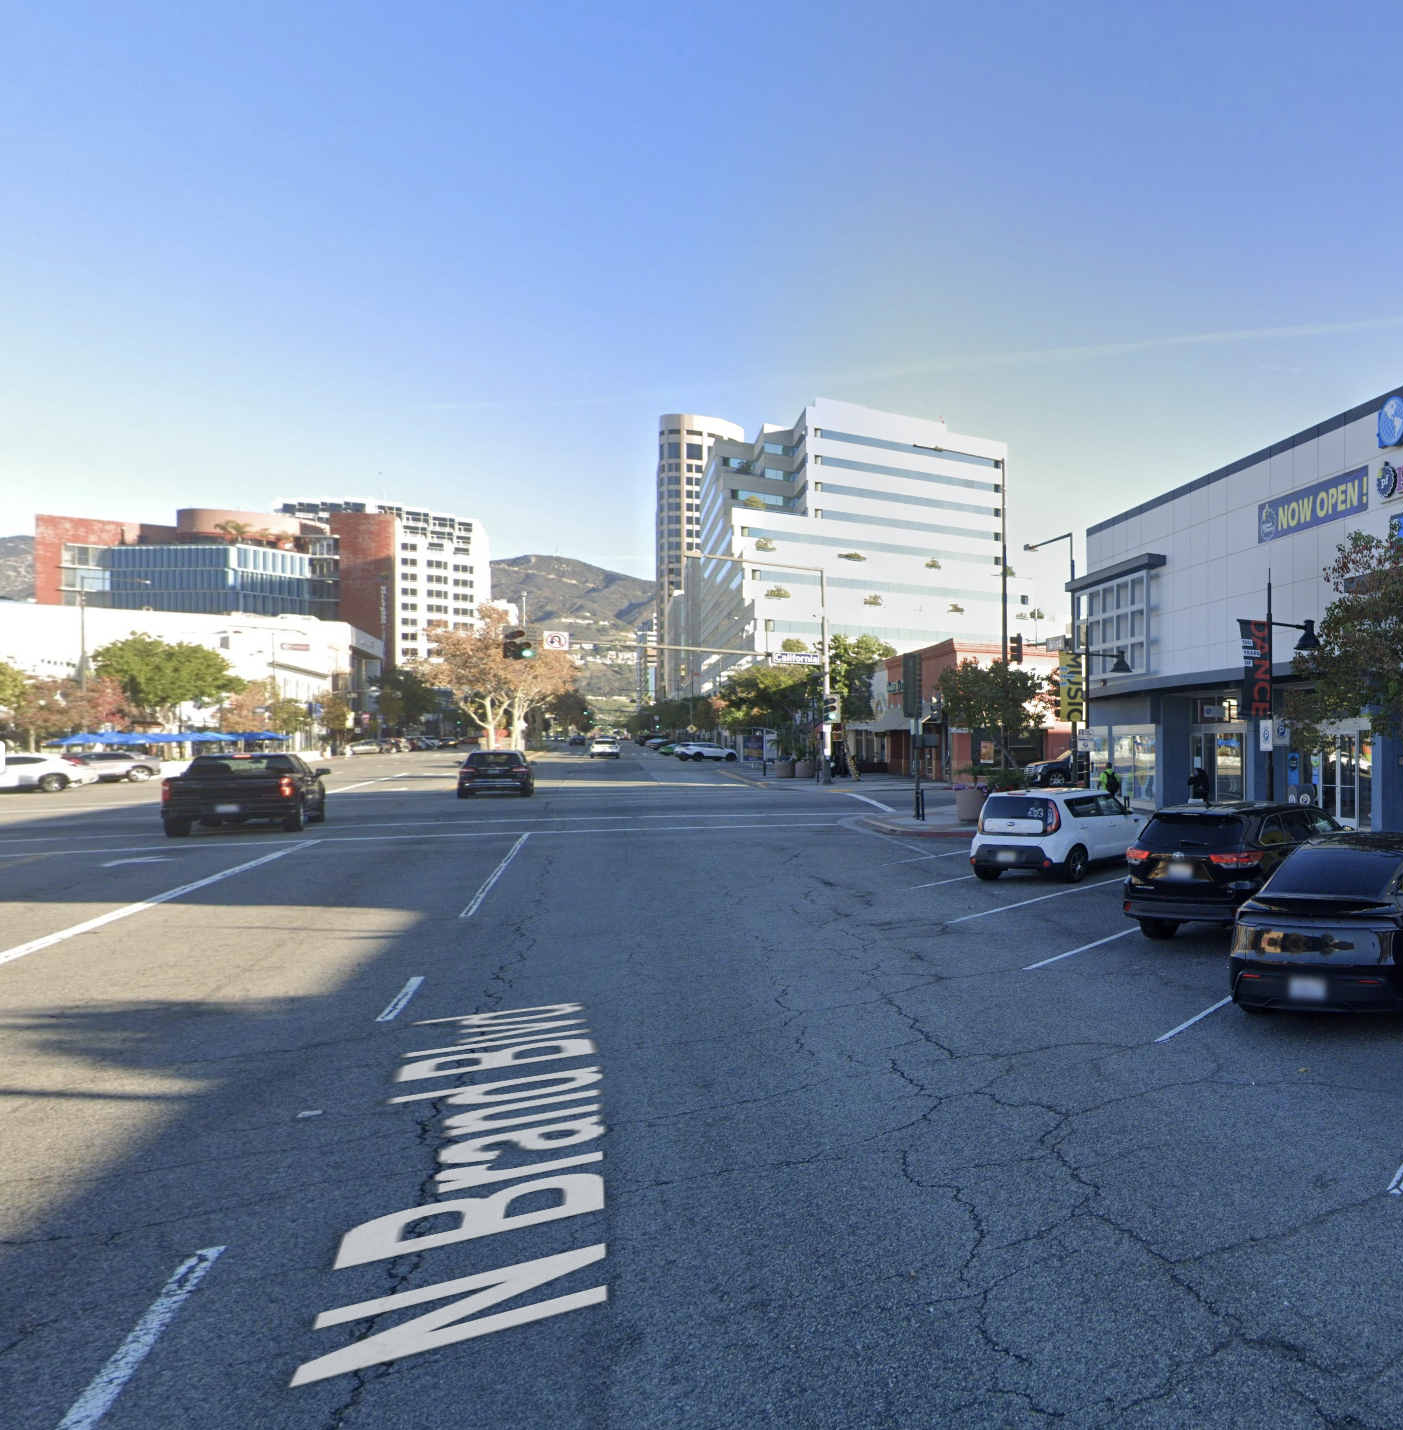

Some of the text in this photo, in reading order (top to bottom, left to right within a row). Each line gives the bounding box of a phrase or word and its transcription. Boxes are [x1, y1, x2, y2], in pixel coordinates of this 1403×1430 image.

[1277, 495, 1314, 531] NOW
[1316, 480, 1359, 518] OPEN
[775, 653, 819, 664] California
[1243, 649, 1261, 657] YEARS
[1250, 619, 1271, 718] DANCE
[1066, 654, 1083, 722] MUSIC
